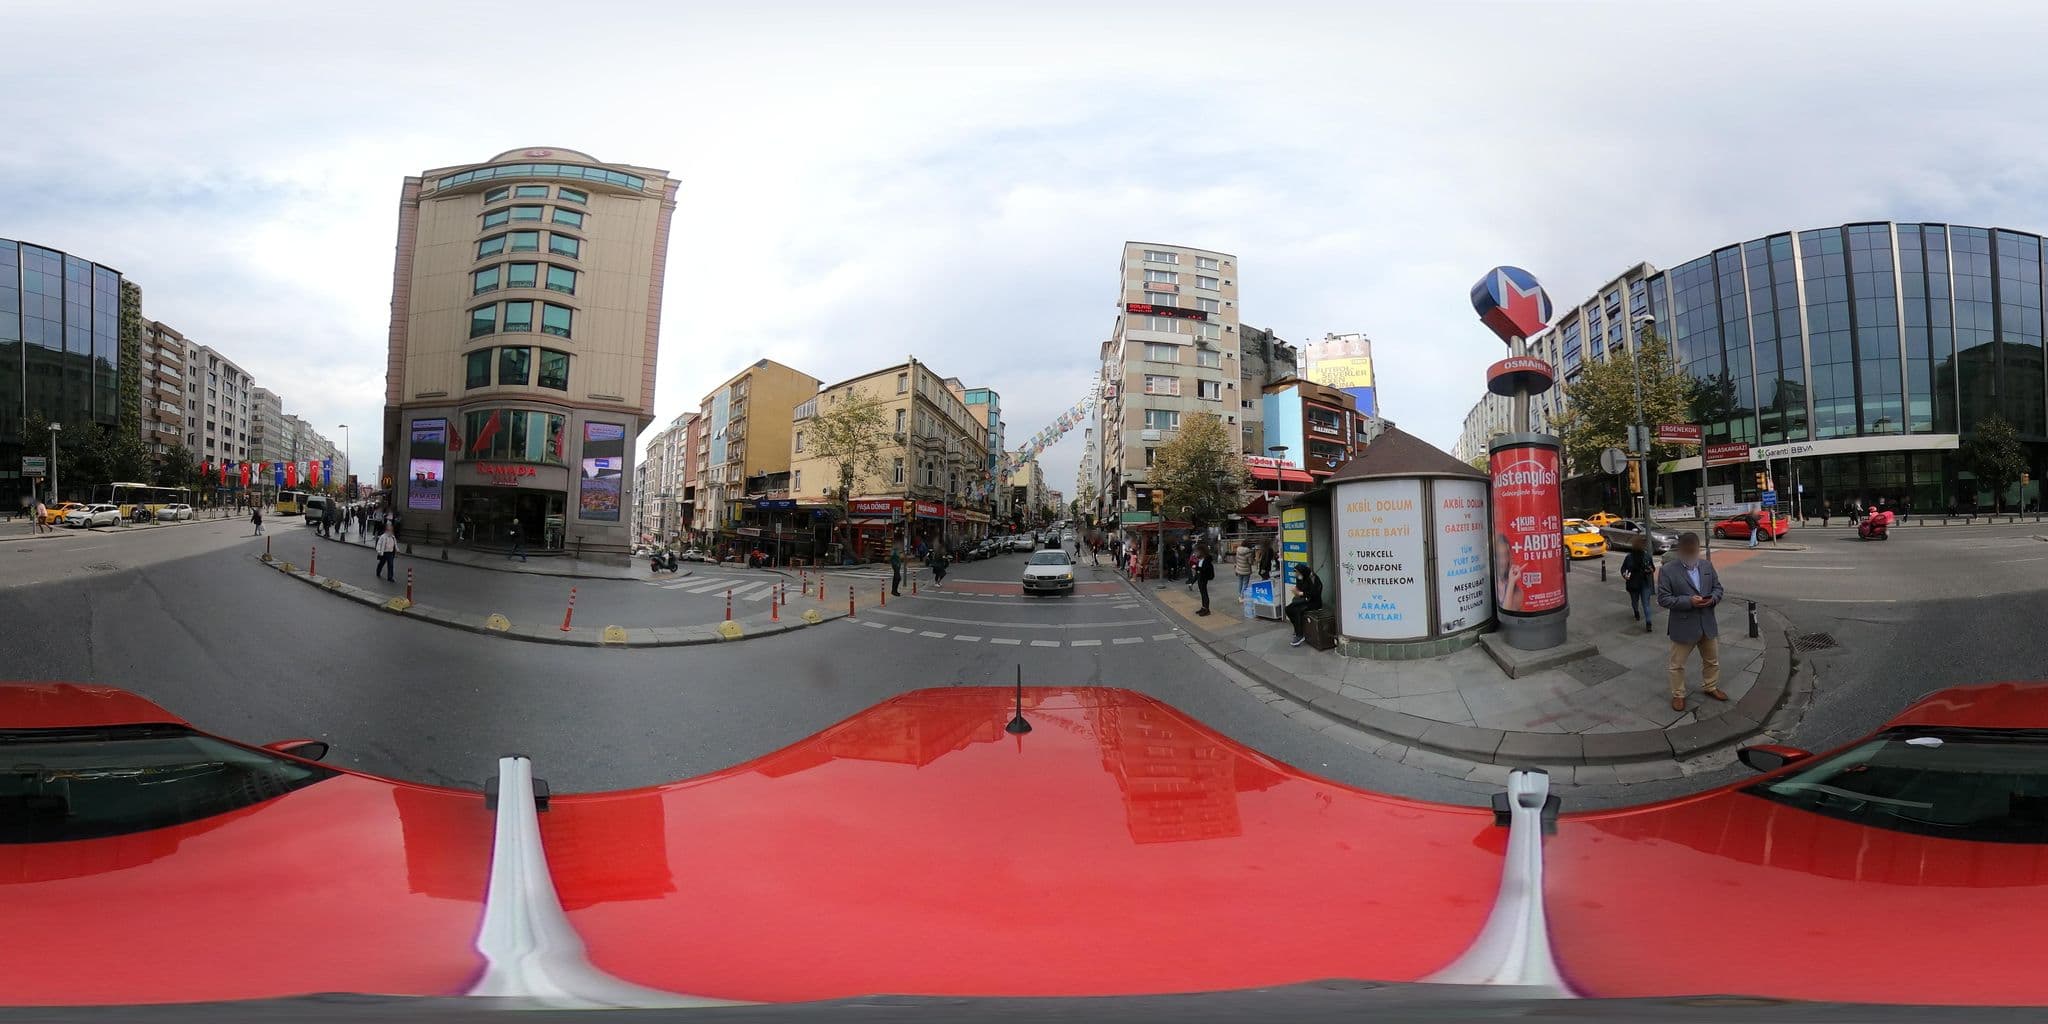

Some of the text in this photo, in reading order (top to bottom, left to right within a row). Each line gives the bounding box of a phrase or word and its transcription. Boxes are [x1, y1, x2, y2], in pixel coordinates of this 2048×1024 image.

[1661, 425, 1697, 433] ERGENEKON
[1707, 444, 1748, 454] HALASKARGAZİ
[1765, 445, 1814, 456] Garanti BBVA
[476, 460, 537, 476] RAMADA
[856, 502, 890, 511] PAŞA DÖNER
[1346, 499, 1413, 512] AKBİL DOLUM
[1443, 496, 1465, 509] AKBİL
[1372, 515, 1383, 523] ve
[1347, 527, 1380, 537] GAZETE
[1524, 533, 1562, 551] ABD'DE
[1357, 550, 1394, 558] TURKCELL
[1524, 550, 1553, 560] DEVAM
[1358, 563, 1402, 571] VODAFONE
[1454, 577, 1485, 592] MEŞRUBAT
[1361, 602, 1396, 610] ARAMA
